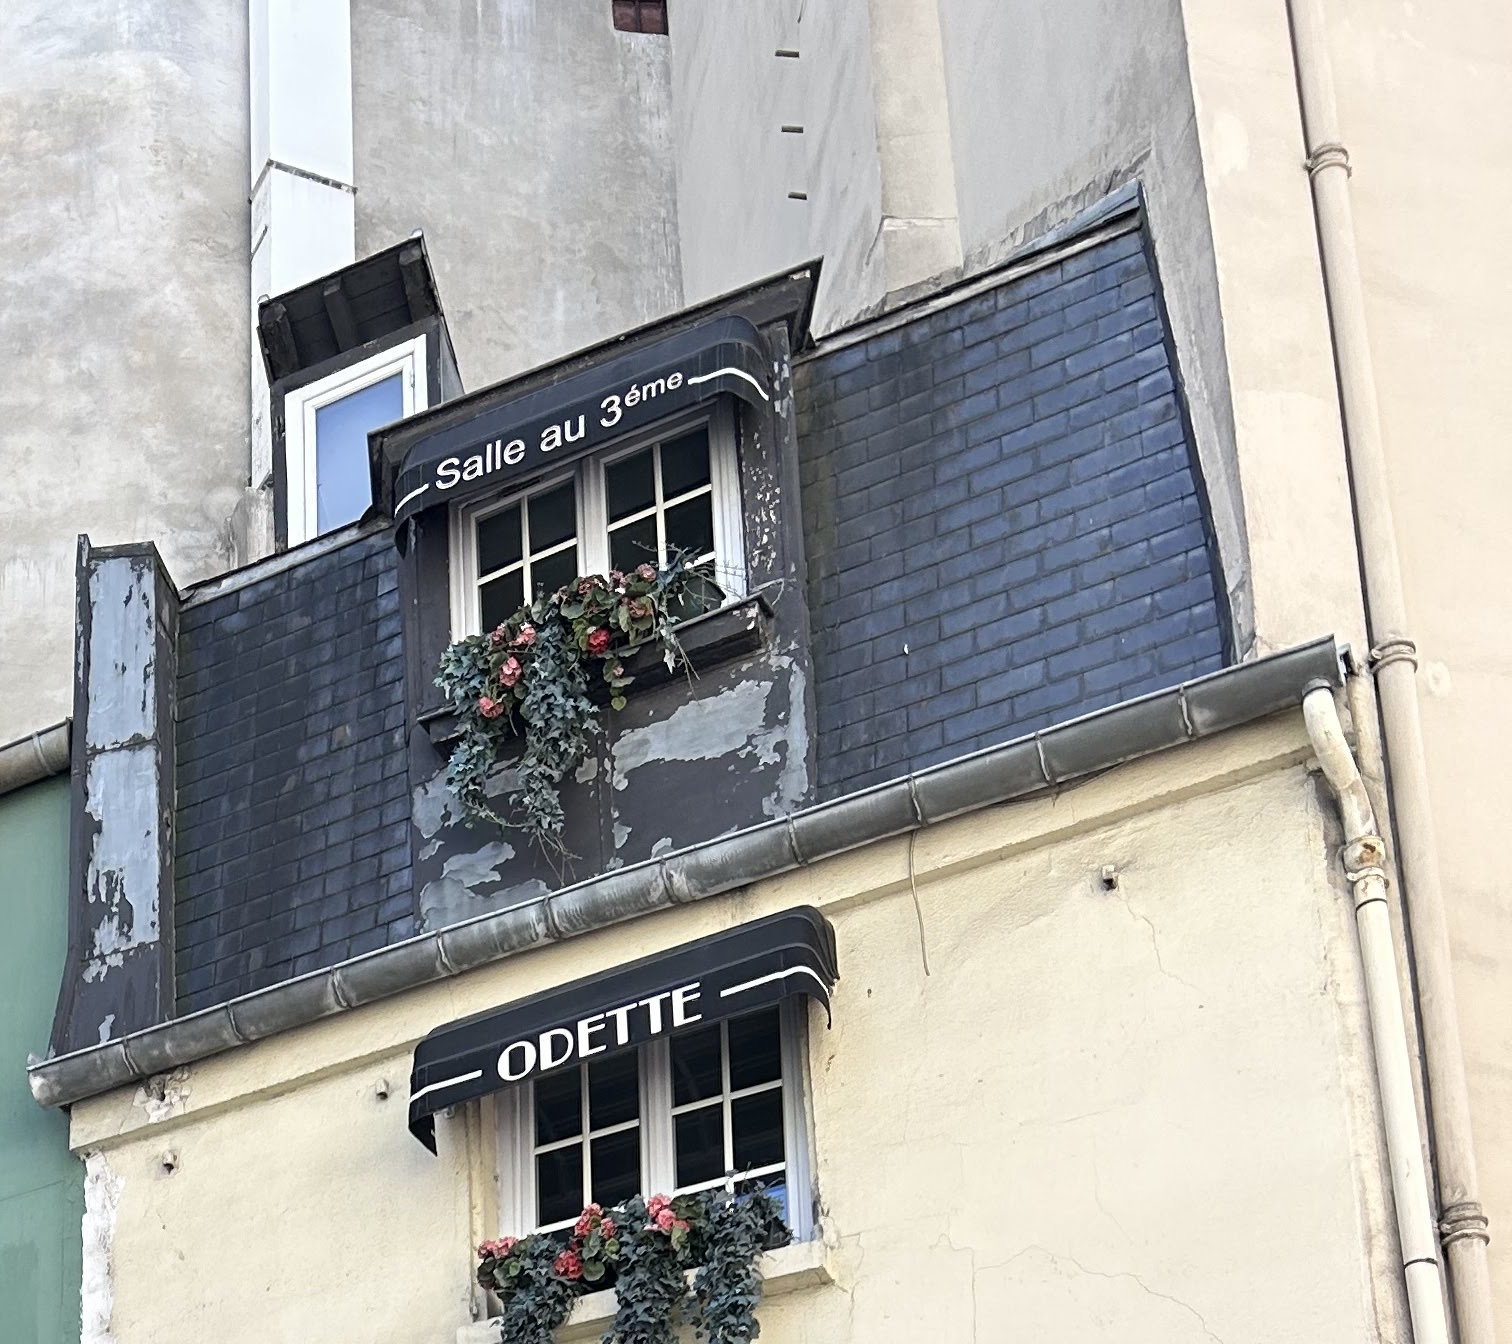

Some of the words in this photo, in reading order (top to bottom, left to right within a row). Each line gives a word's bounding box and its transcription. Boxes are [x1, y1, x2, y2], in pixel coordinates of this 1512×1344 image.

[434, 439, 526, 491] Salle
[539, 413, 587, 453] au
[497, 981, 704, 1082] ODETTE
